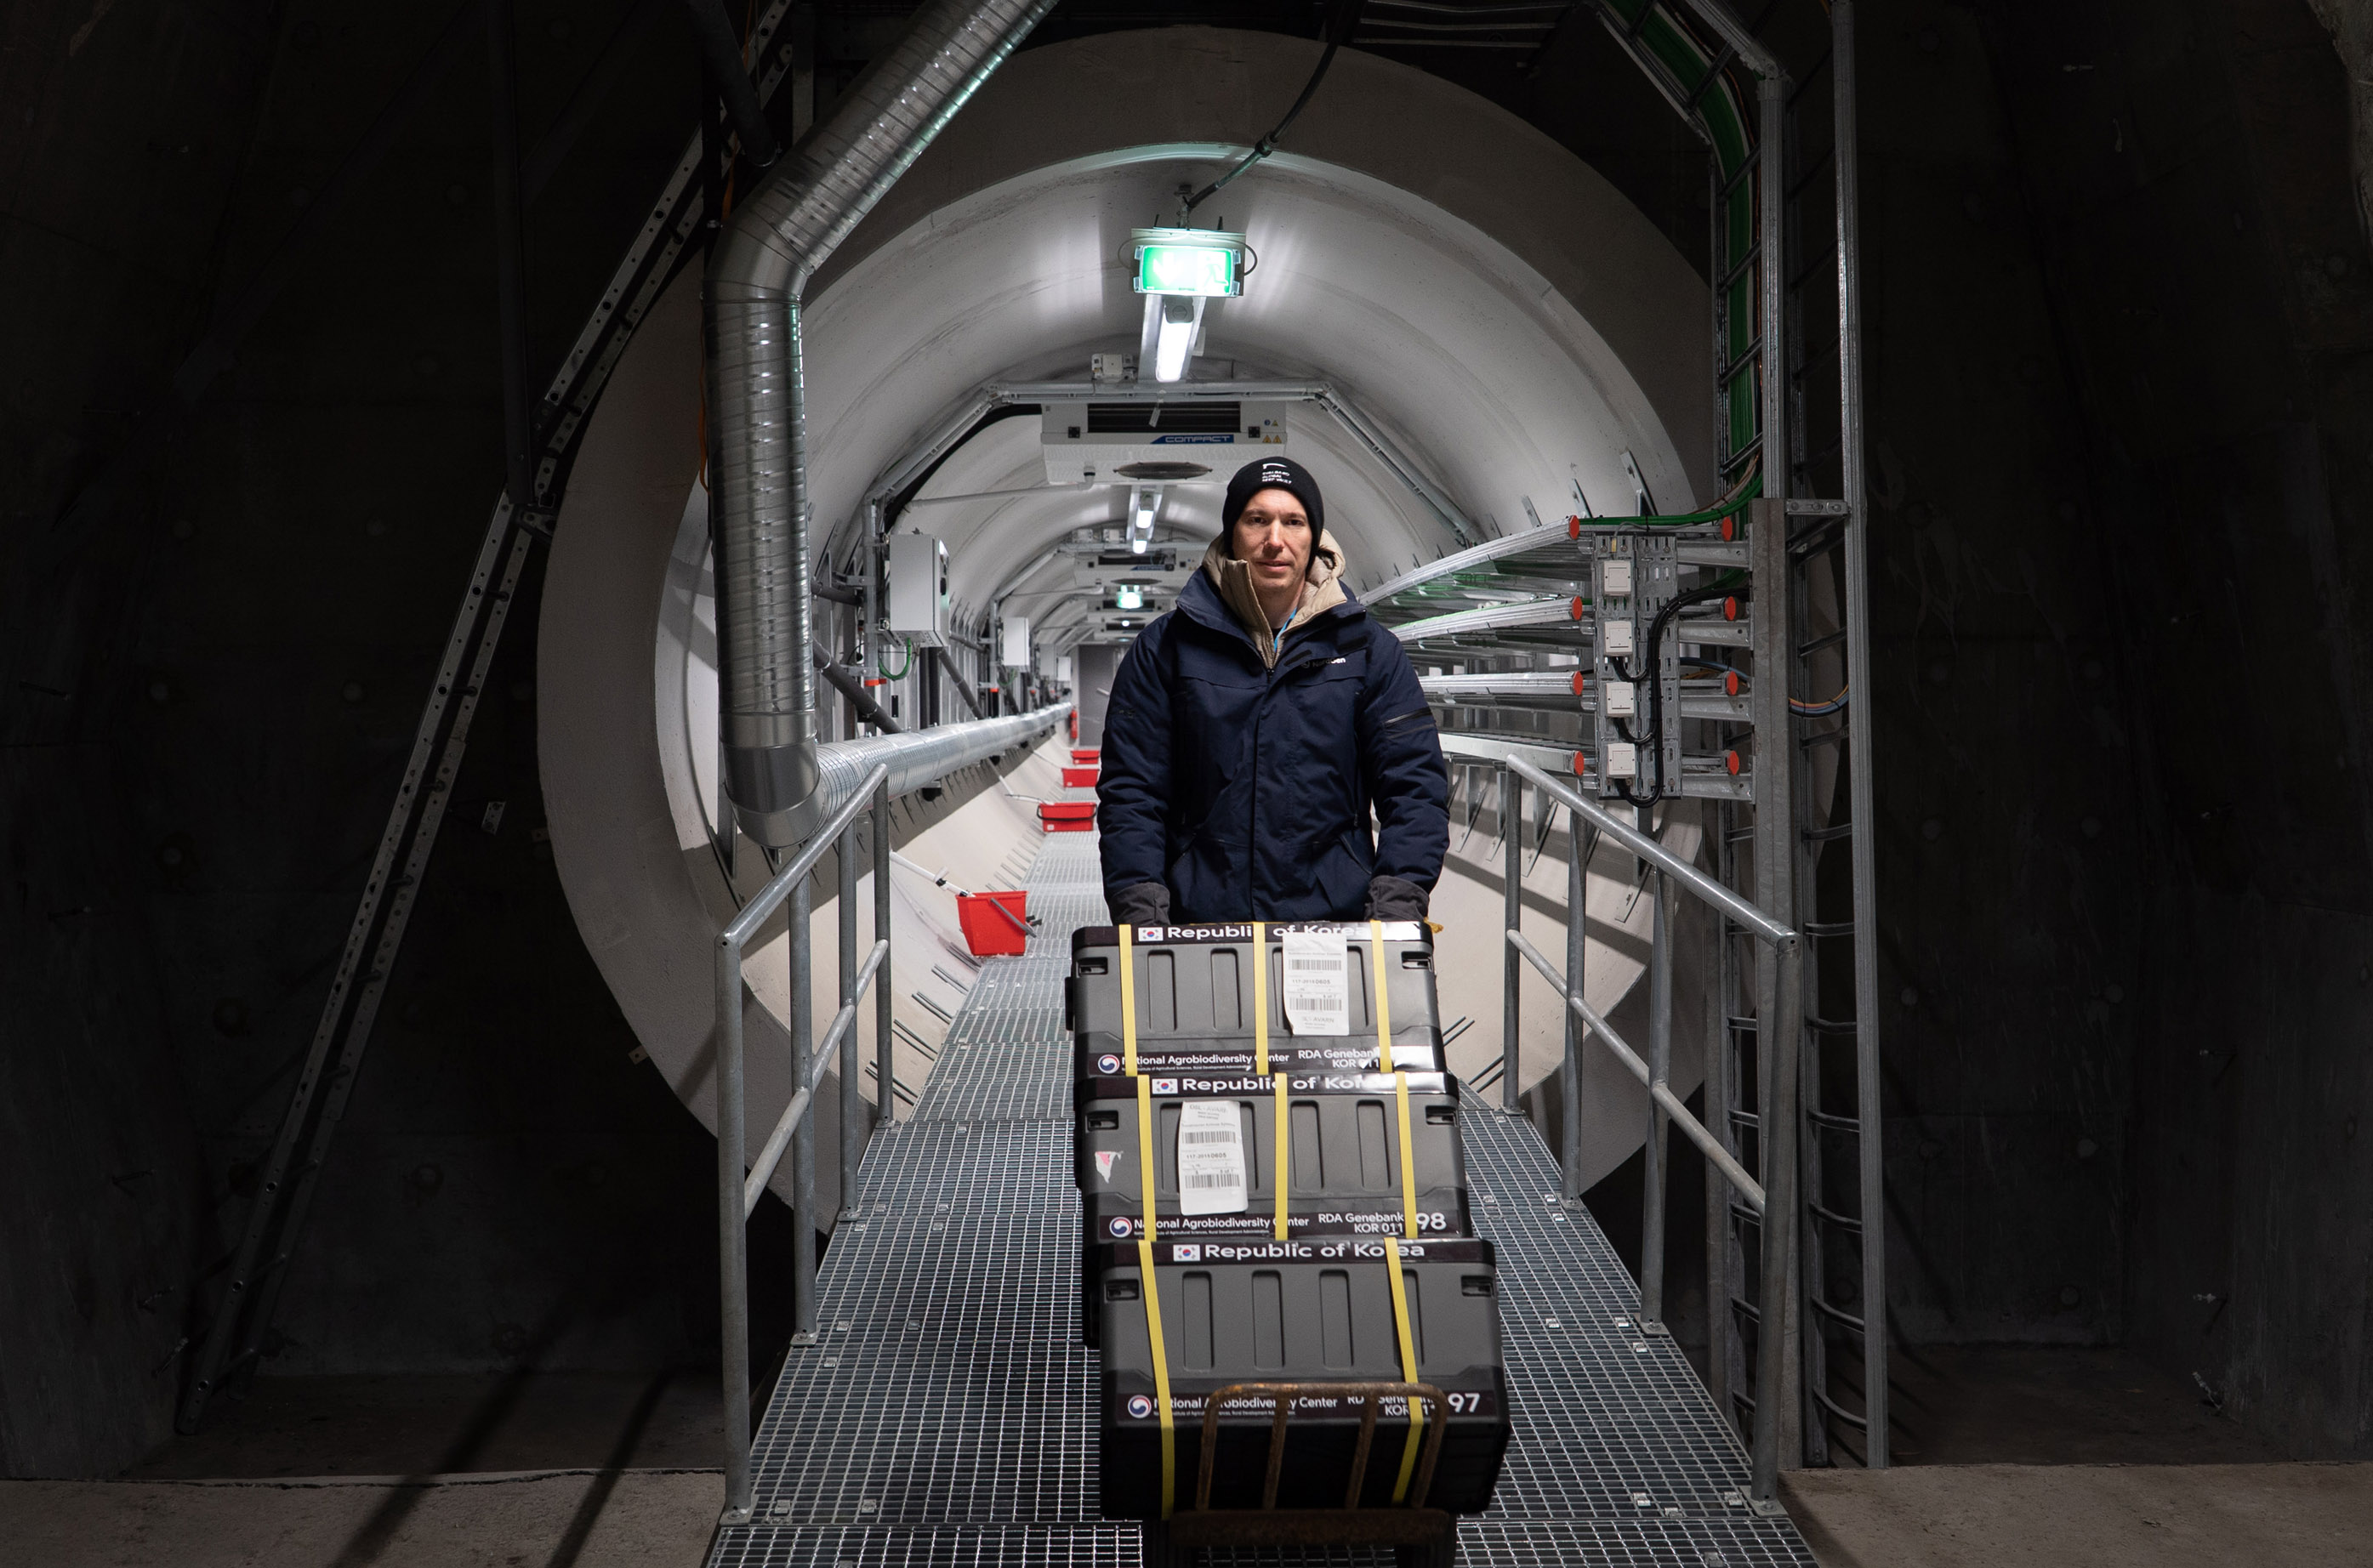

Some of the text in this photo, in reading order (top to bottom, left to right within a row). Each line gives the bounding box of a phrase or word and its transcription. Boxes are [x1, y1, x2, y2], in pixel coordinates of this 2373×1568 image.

[1168, 925, 1252, 940] Republi
[1273, 925, 1296, 936] of
[1168, 1054, 1253, 1065] Agrobiodiversity
[1298, 1050, 1322, 1059] RDA
[1332, 1060, 1357, 1068] KOR
[1293, 1077, 1316, 1089] of
[1134, 1219, 1180, 1229] Nonal
[1182, 1217, 1270, 1230] Agrobiodiversity
[1318, 1212, 1404, 1223] RDA Genebank
[1415, 1212, 1447, 1230] 98
[1354, 1223, 1403, 1233] KOR 011
[1205, 1243, 1426, 1260] Republic of Koea
[1300, 1396, 1338, 1408] Center
[1448, 1394, 1480, 1413] 97
